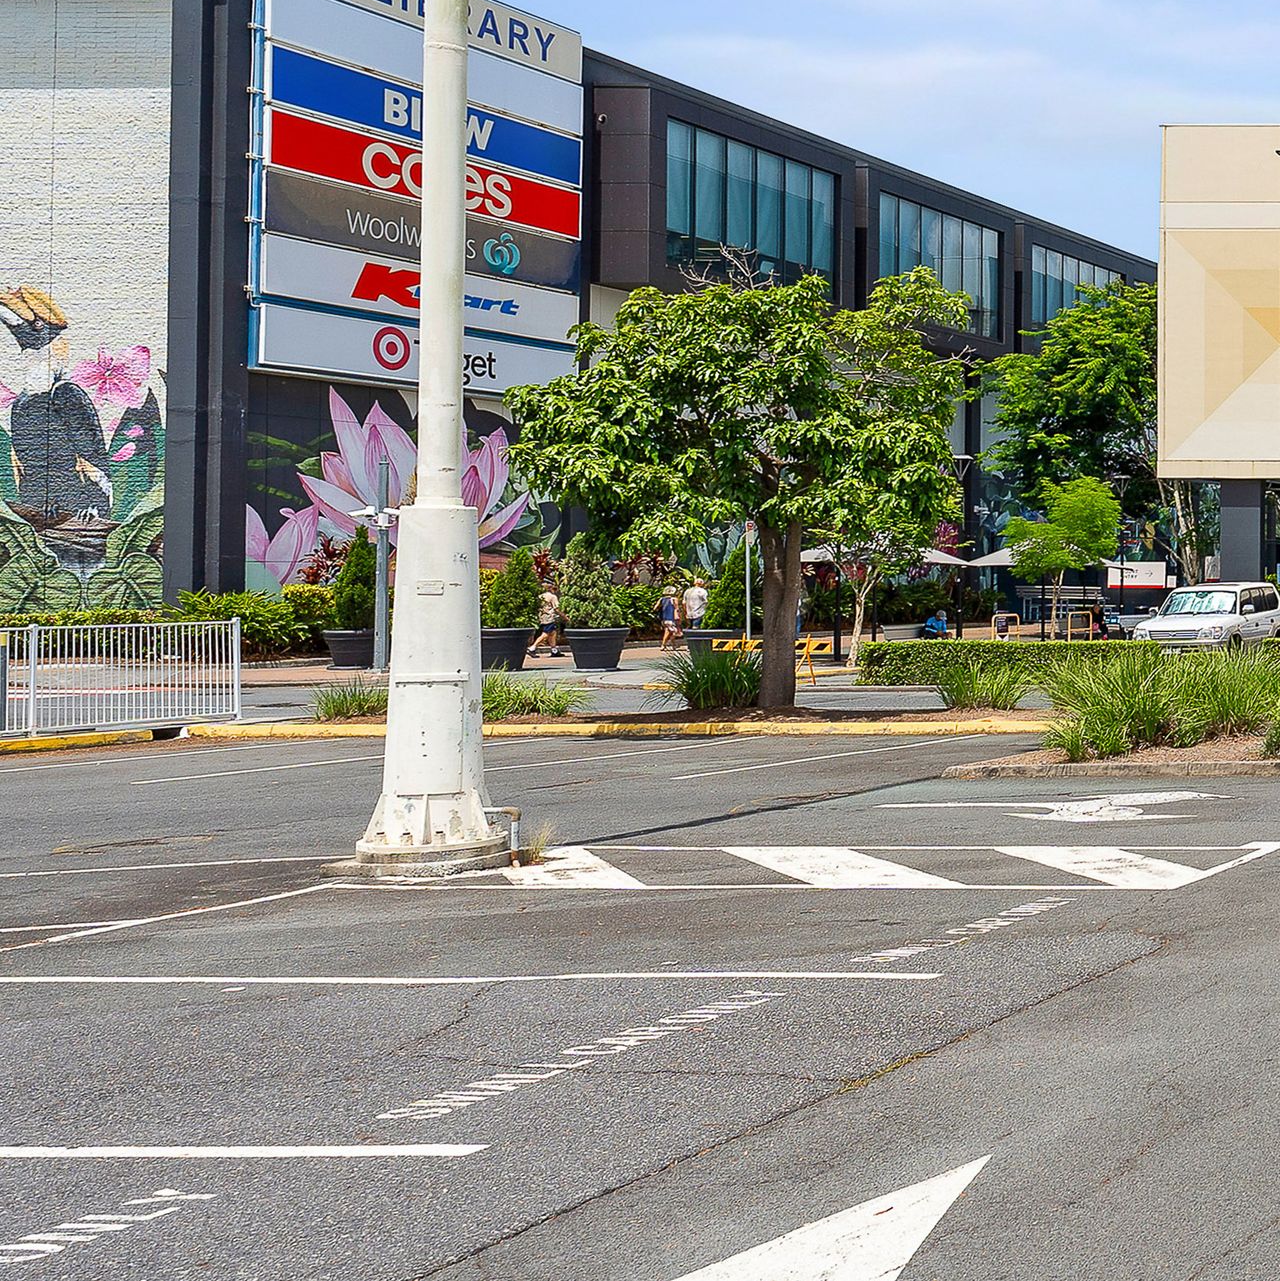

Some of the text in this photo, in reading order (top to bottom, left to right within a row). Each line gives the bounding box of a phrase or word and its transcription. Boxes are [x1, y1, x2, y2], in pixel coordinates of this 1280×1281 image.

[346, 208, 476, 259] Woolws
[351, 262, 520, 316] Kart
[375, 991, 788, 1120] SMALL CAR ONLY
